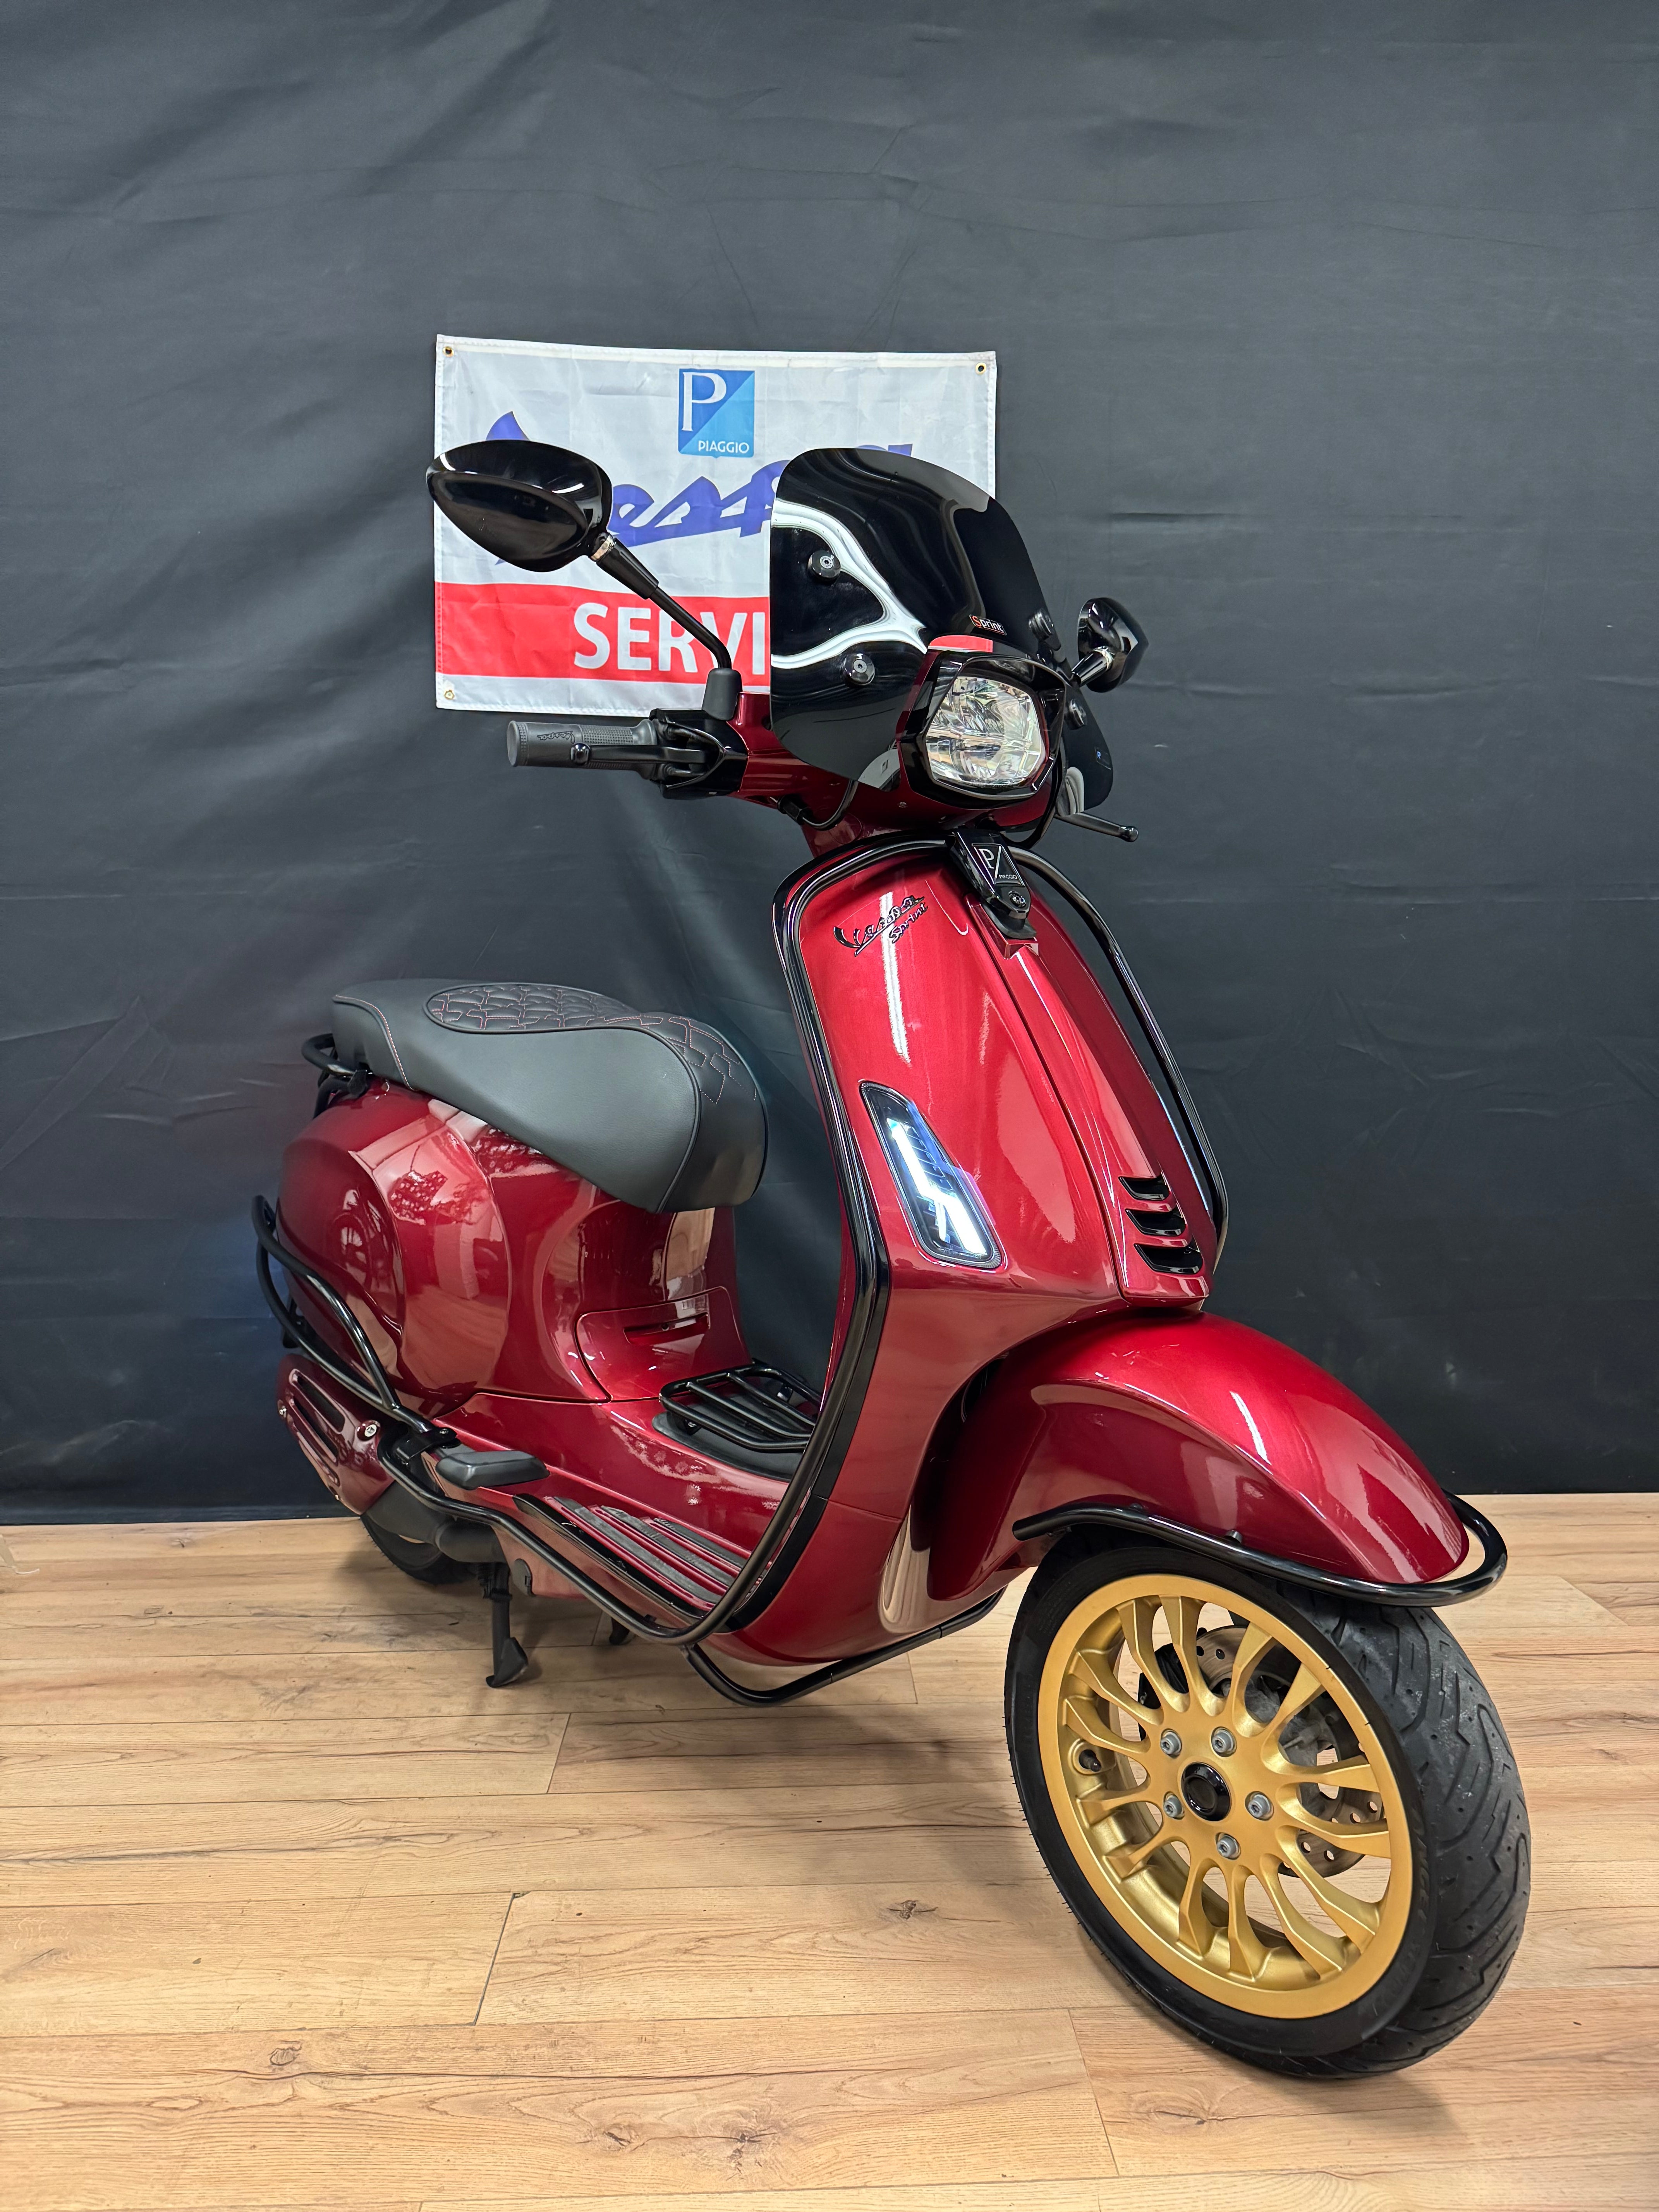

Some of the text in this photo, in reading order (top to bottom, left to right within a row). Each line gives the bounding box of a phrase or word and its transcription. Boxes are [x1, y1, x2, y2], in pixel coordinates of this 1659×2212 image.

[682, 372, 727, 431] P
[698, 440, 750, 454] PIAGGIO
[574, 602, 766, 675] SERVI
[972, 615, 1004, 632] Sprint
[536, 730, 575, 744] Vespa
[978, 848, 995, 869] P
[833, 895, 925, 957] Vespa
[889, 902, 928, 943] Sprint
